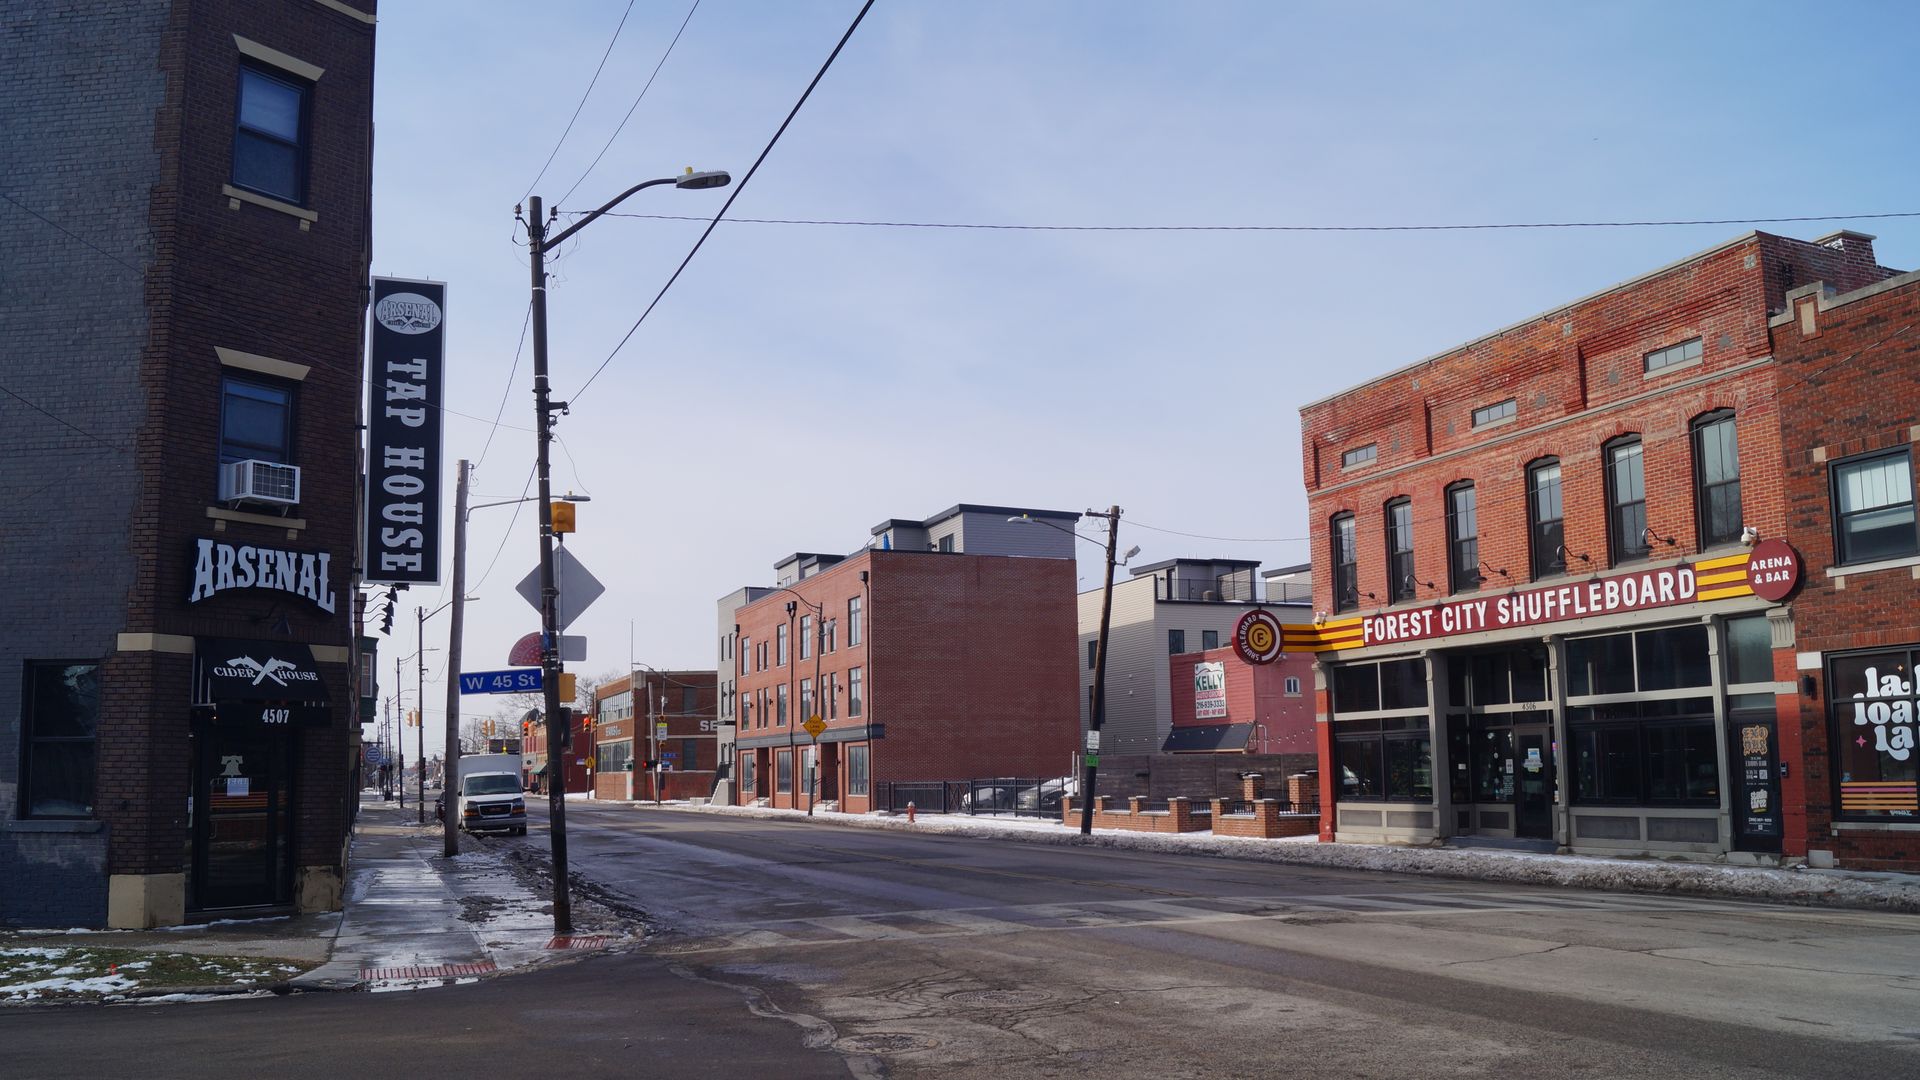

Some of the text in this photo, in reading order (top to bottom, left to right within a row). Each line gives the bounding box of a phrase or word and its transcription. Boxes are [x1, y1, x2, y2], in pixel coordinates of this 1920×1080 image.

[381, 300, 437, 326] ARSENAL
[385, 358, 427, 428] TAP
[381, 445, 425, 572] HOUSE
[191, 538, 335, 615] ARSENAL
[1751, 556, 1793, 571] ARENA
[1755, 569, 1790, 584] & BAR
[1363, 569, 1696, 643] FOREST CITY SHUFFLEBOARD
[1240, 614, 1260, 661] SHUFFLEBOARD
[213, 666, 318, 682] CIDER HOUSE
[466, 674, 535, 690] W 45 St
[1196, 673, 1223, 691] KELLY
[1865, 667, 1910, 698] la
[262, 709, 290, 724] 4507
[1874, 725, 1914, 761] la
